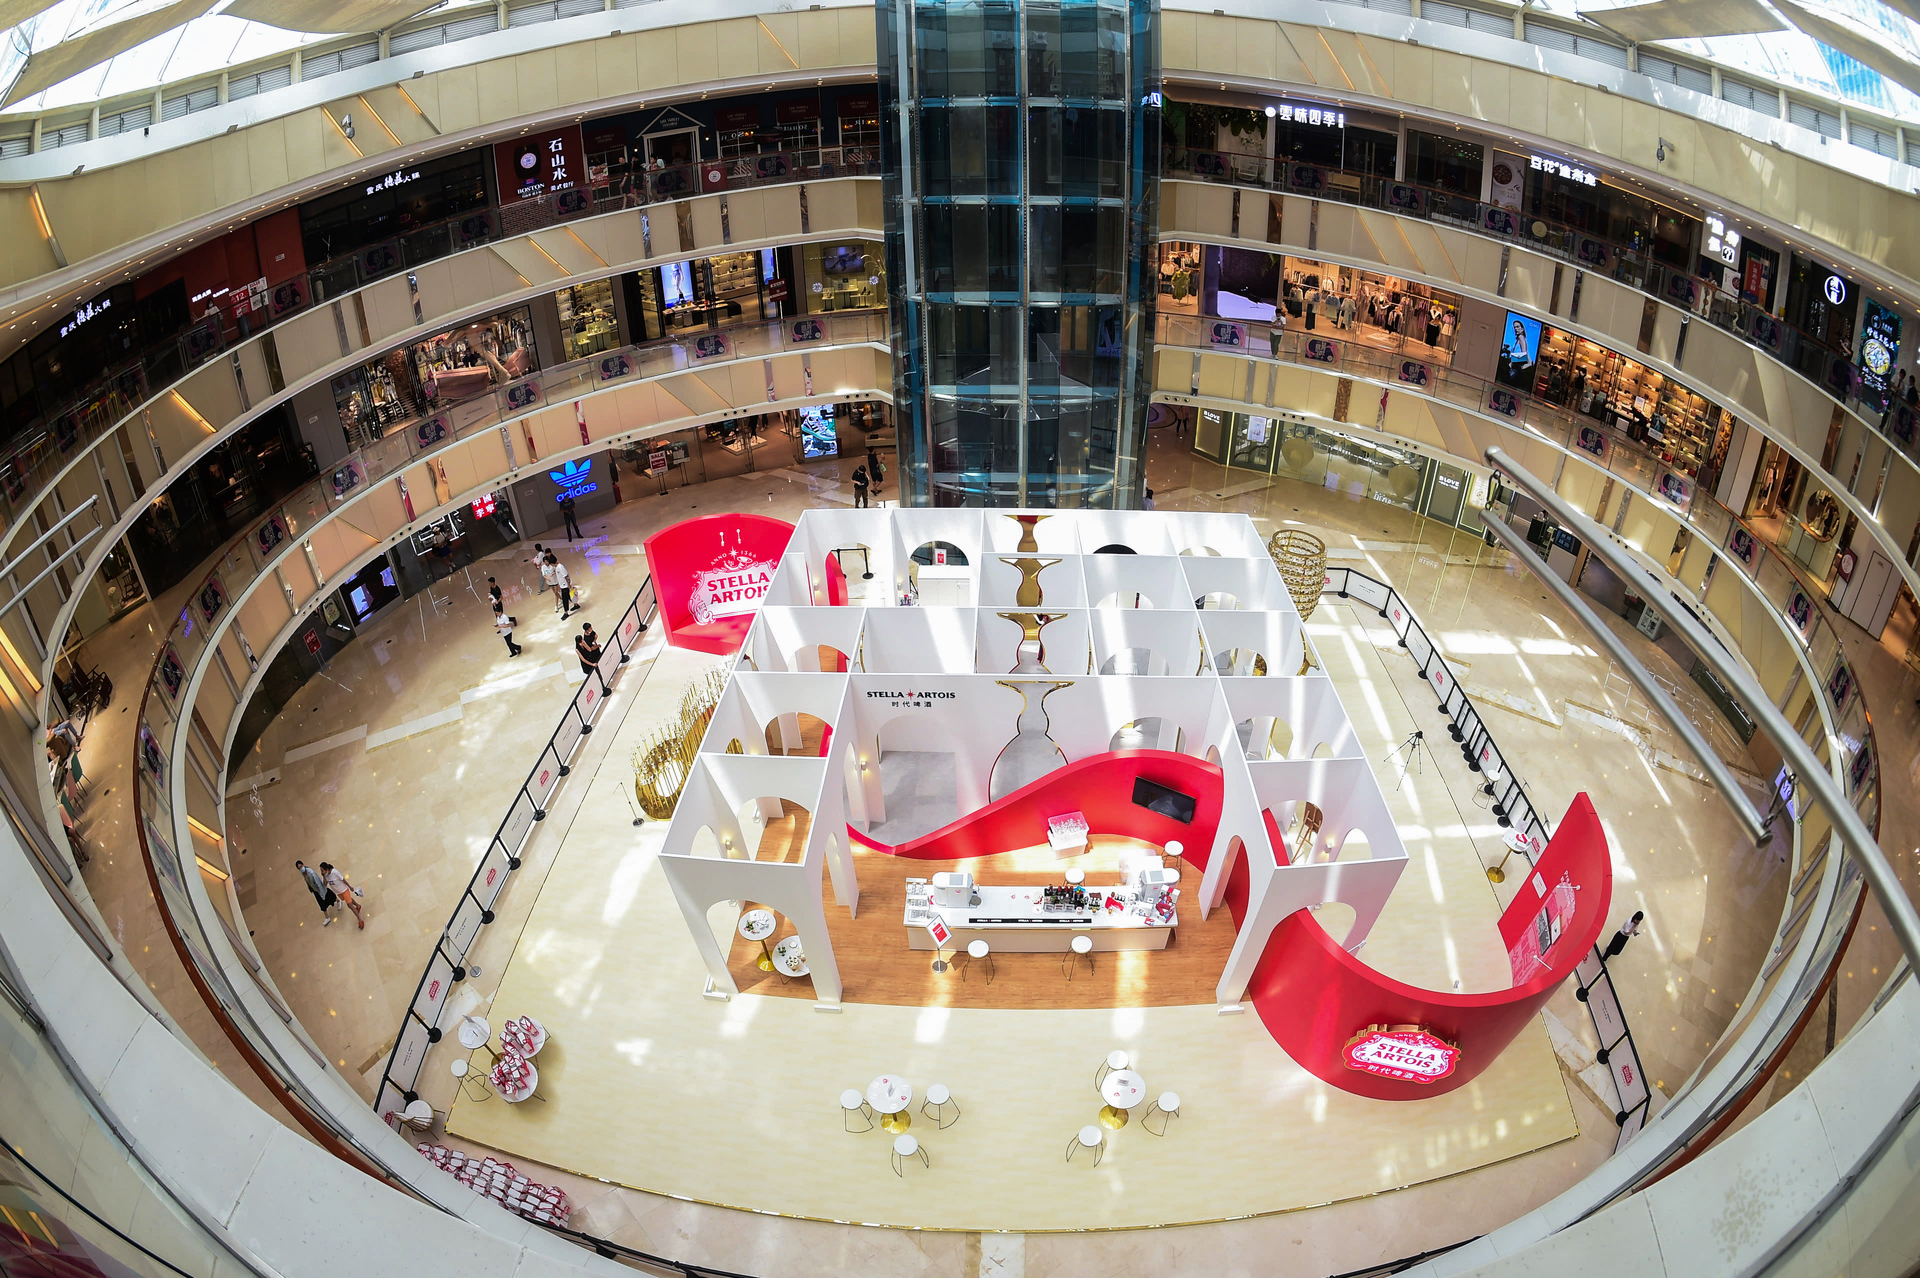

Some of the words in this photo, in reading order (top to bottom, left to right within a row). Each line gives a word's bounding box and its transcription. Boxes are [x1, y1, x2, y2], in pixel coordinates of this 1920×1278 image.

[1279, 104, 1336, 128] 雲味四季
[548, 137, 568, 181] 石山水
[517, 182, 545, 195] BOSTON
[1439, 475, 1460, 486] BLOVE
[710, 552, 728, 566] ANNO
[740, 550, 757, 559] 1366
[707, 571, 771, 592] STELLA
[916, 691, 956, 699] ARTOIS
[1370, 1051, 1432, 1068] ARTOIS
[1376, 1043, 1436, 1062] STELLA
[1367, 1065, 1415, 1079] 时代啤酒
